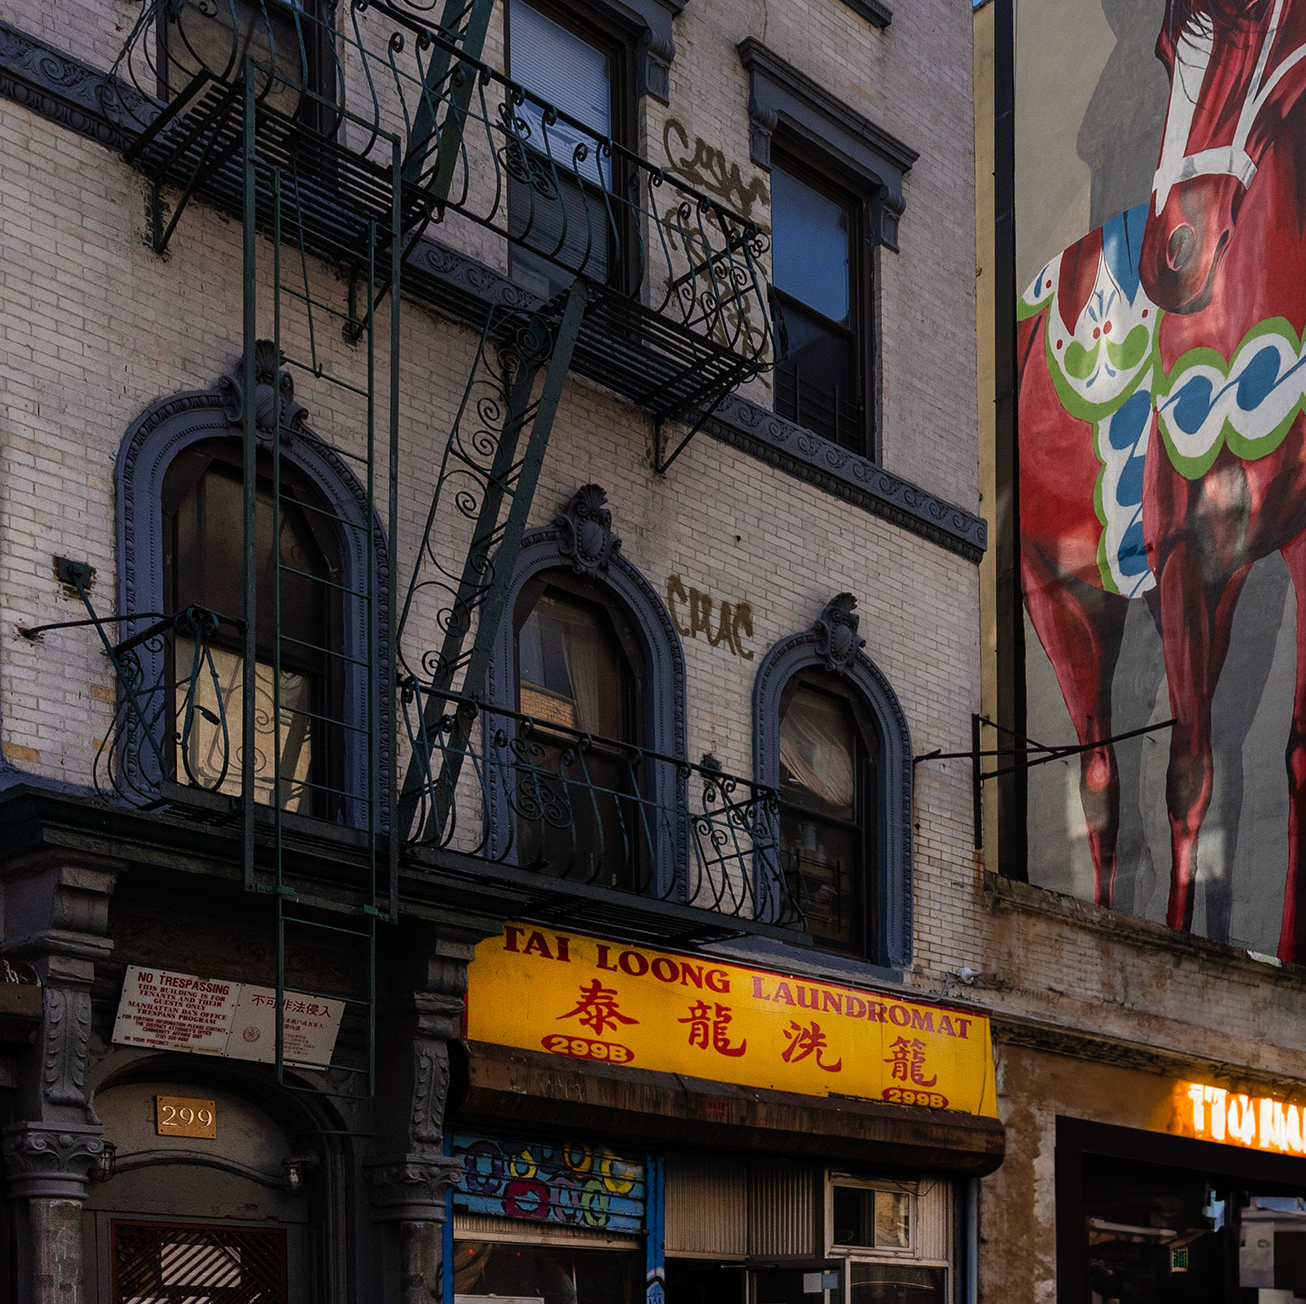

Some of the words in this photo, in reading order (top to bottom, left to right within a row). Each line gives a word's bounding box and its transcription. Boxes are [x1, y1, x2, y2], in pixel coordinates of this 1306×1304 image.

[137, 971, 153, 983] NO
[159, 974, 230, 995] TRESPASSING
[138, 983, 157, 991] THIS
[160, 986, 197, 998] BUILDING
[210, 994, 226, 1002] FOR
[502, 926, 571, 963] TAI
[596, 943, 731, 994] LOONG
[751, 975, 973, 1040] LAUNDROMAT
[139, 990, 176, 1001] TENANTS
[179, 995, 195, 1003] AND
[198, 998, 222, 1007] THEIR
[153, 998, 183, 1007] GUESTS
[185, 1003, 206, 1011] ONLY
[128, 1000, 178, 1013] MANHATTAN
[200, 1012, 227, 1020] OFFICE
[137, 1008, 176, 1019] TRESPASS
[178, 1014, 217, 1025] PROGRAM
[550, 1036, 628, 1062] 299B
[888, 1089, 944, 1108] 299B
[162, 1105, 213, 1129] 299
